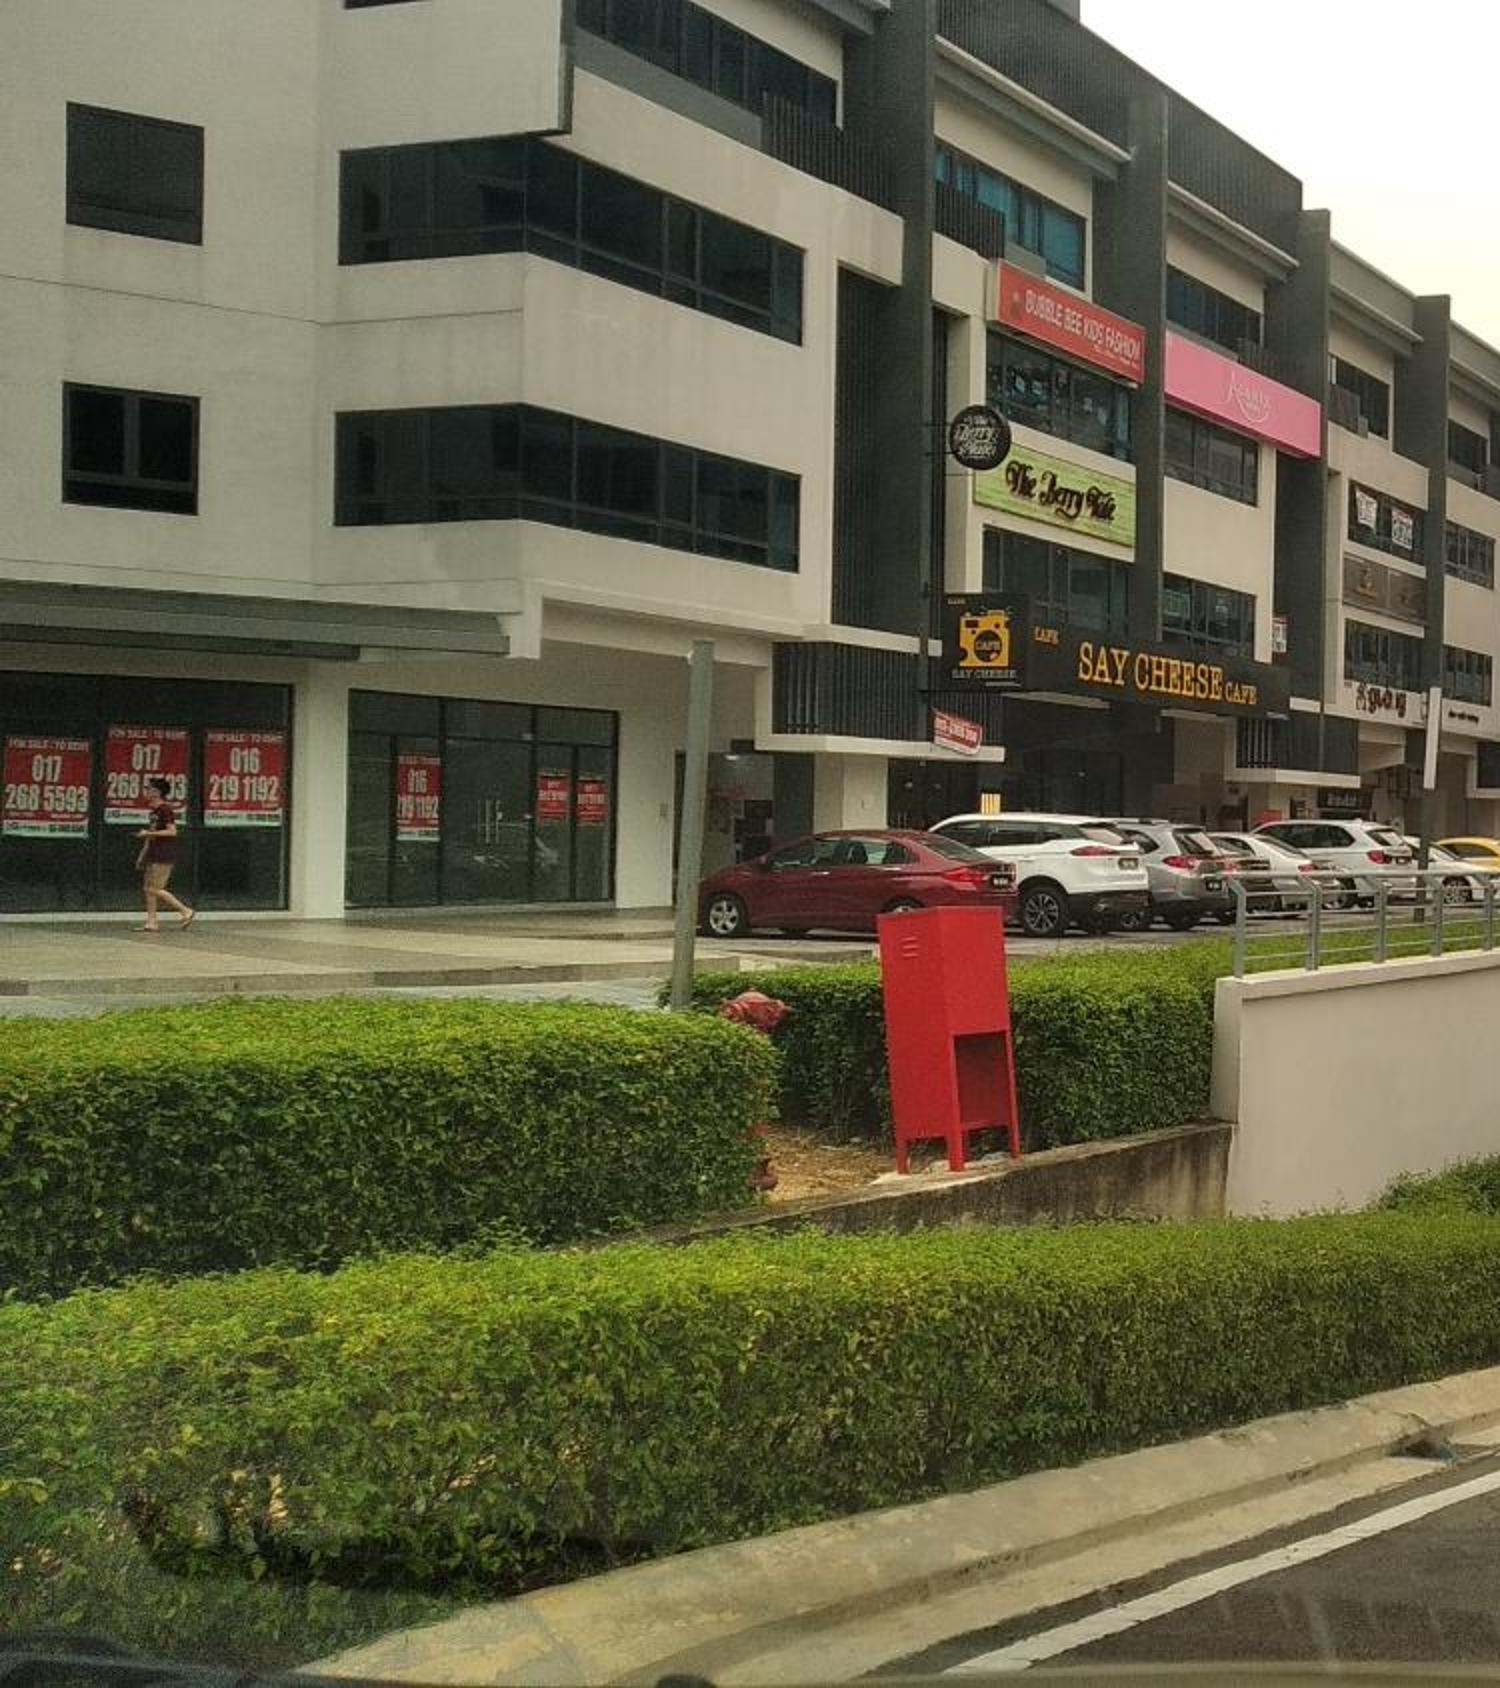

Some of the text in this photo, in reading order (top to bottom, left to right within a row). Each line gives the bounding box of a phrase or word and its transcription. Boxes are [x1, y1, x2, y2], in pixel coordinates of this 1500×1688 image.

[1025, 289, 1063, 328] BUBBLE
[1063, 308, 1083, 335] BEE
[1083, 317, 1105, 345] KIDS
[1105, 326, 1141, 360] FASHION
[1005, 460, 1037, 499] The
[1039, 470, 1085, 519] Berry
[1078, 641, 1257, 704] SAY CHEESE CAFE
[32, 754, 62, 782] 017
[132, 743, 161, 770] 017
[230, 747, 260, 774] 016
[5, 783, 89, 813] 268 5593
[107, 772, 140, 799] 268
[209, 775, 280, 801] 219 1192
